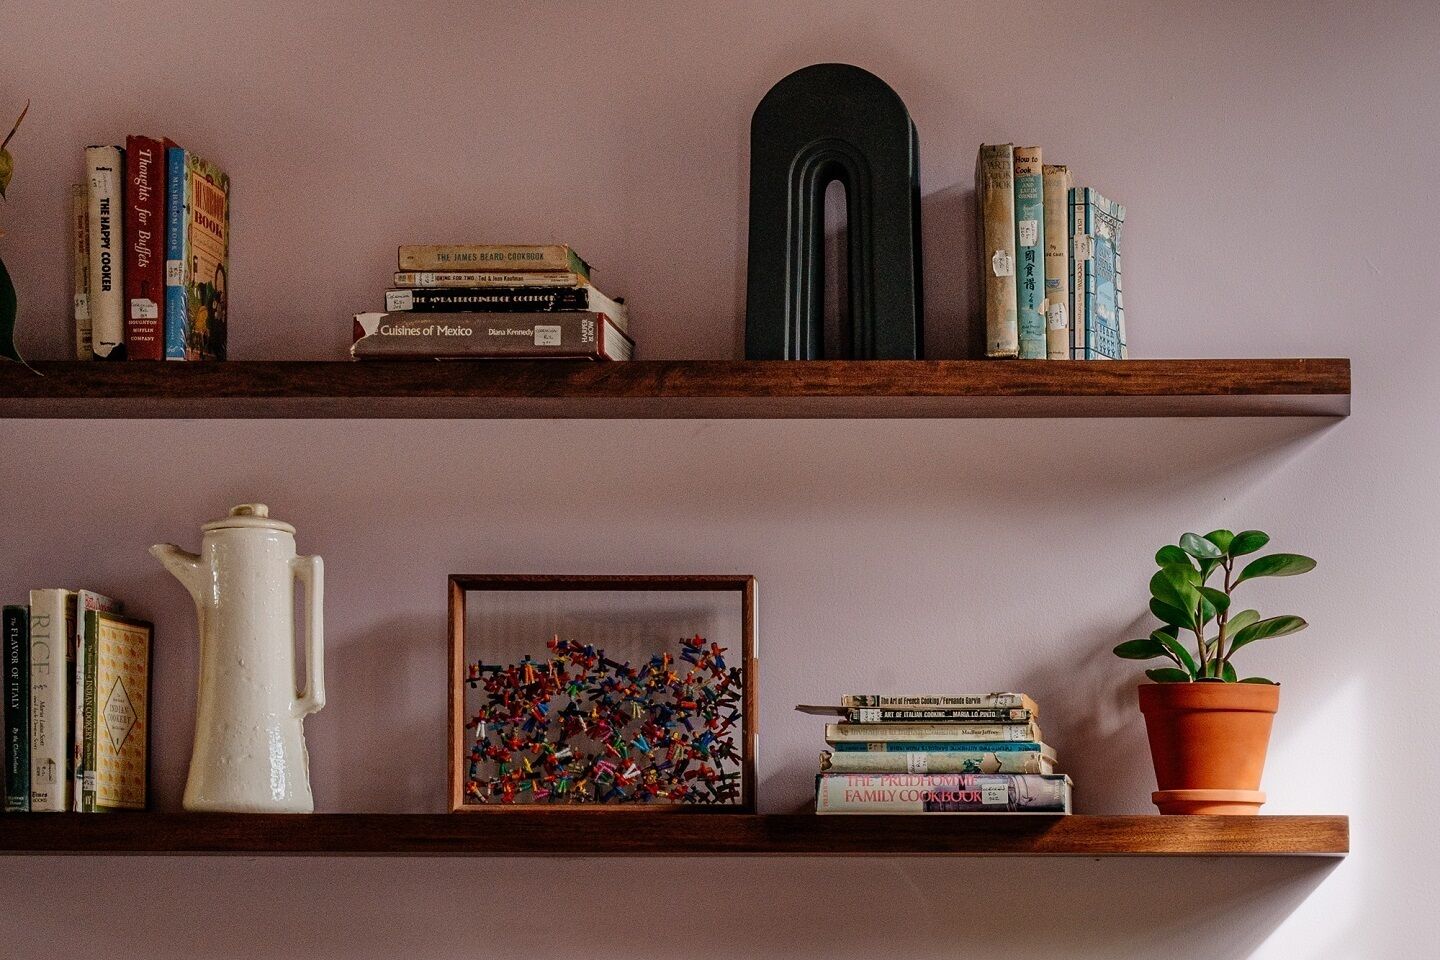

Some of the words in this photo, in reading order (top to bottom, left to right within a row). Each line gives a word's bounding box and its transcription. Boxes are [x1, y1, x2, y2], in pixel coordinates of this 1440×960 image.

[134, 148, 152, 202] Thoughts
[100, 198, 110, 216] THE
[172, 176, 180, 224] MUSHROOM
[133, 208, 151, 226] for
[194, 208, 224, 239] BOOK
[100, 217, 111, 250] HAPPY
[134, 230, 152, 268] Buffets
[437, 253, 450, 261] THE
[454, 253, 477, 261] JAMES
[480, 252, 504, 261] BEARD
[507, 252, 544, 261] COOKBOOK
[102, 251, 112, 292] COOKER
[380, 325, 420, 336] Cuisines
[422, 325, 434, 336] of
[437, 325, 473, 336] Mexico
[507, 328, 534, 337] Kennedy
[31, 614, 50, 674] RICE
[12, 667, 19, 680] OF
[847, 775, 874, 786] THE
[880, 775, 977, 786] PRUDHOMME
[845, 790, 897, 803] FAMILY
[899, 790, 982, 803] COOKBOOK
